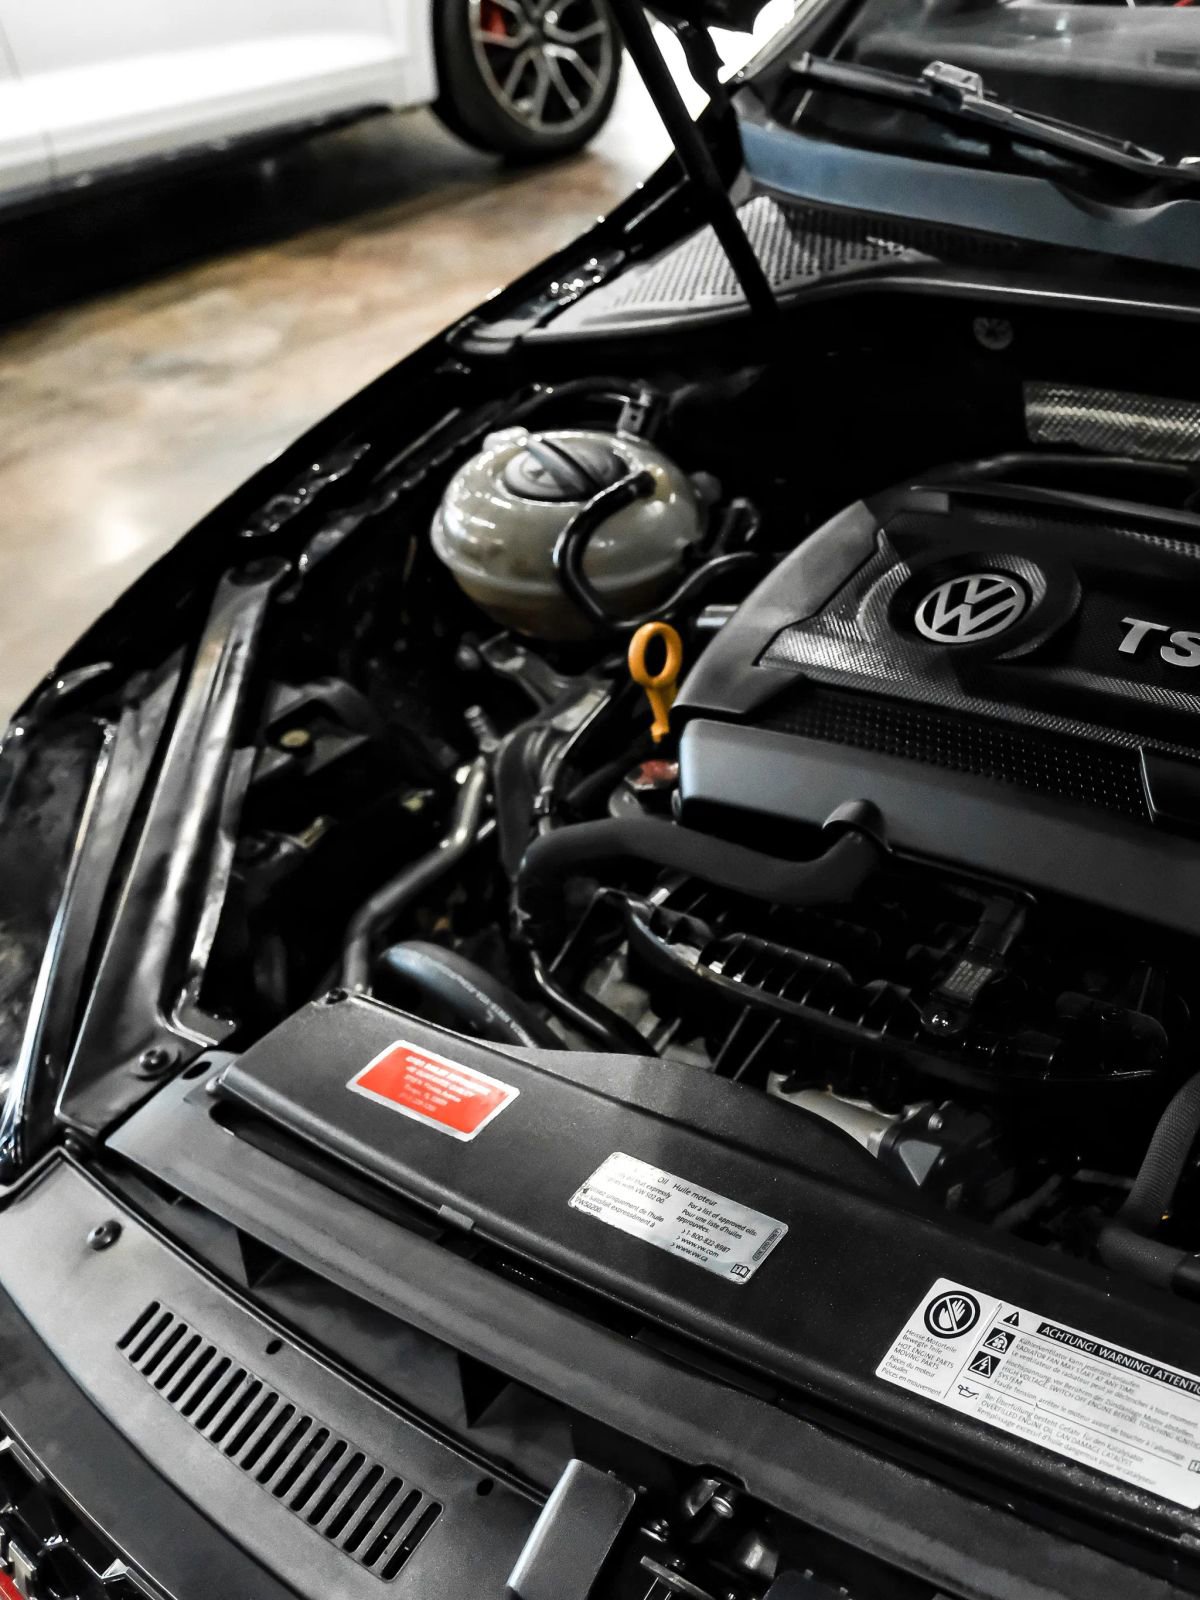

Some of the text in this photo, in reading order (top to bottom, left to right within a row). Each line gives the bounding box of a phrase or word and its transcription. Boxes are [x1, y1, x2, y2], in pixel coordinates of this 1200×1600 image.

[646, 1184, 672, 1199] expressly
[657, 1176, 717, 1206] Oil Huile moteur
[681, 1208, 742, 1239] Pour une liste d'huiles
[687, 1201, 699, 1210] For
[701, 1207, 713, 1216] list
[718, 1216, 747, 1231] approved
[675, 1244, 708, 1262] www.vw.ca
[681, 1238, 719, 1257] www.vw.com
[893, 1347, 939, 1370] MOVING PARTS
[897, 1341, 954, 1369] HOT ENGINE PARTS
[1041, 1326, 1097, 1352] ACHTUNG!
[1099, 1347, 1154, 1375] WARNING!
[1068, 1357, 1084, 1367] kann
[914, 1366, 936, 1378] moteur
[1015, 1343, 1046, 1359] RADIATOR
[1046, 1355, 1060, 1365] FAN
[1060, 1361, 1075, 1371] MAY
[1102, 1378, 1119, 1388] ANY
[906, 1378, 941, 1396] mouvement
[1001, 1366, 1019, 1376] HIGH
[1049, 1384, 1073, 1397] SWITCH
[1073, 1394, 1087, 1403] OFF
[1087, 1400, 1112, 1414] ENGINE
[1018, 1415, 1042, 1429] ENGINE
[1055, 1431, 1070, 1441] CAN
